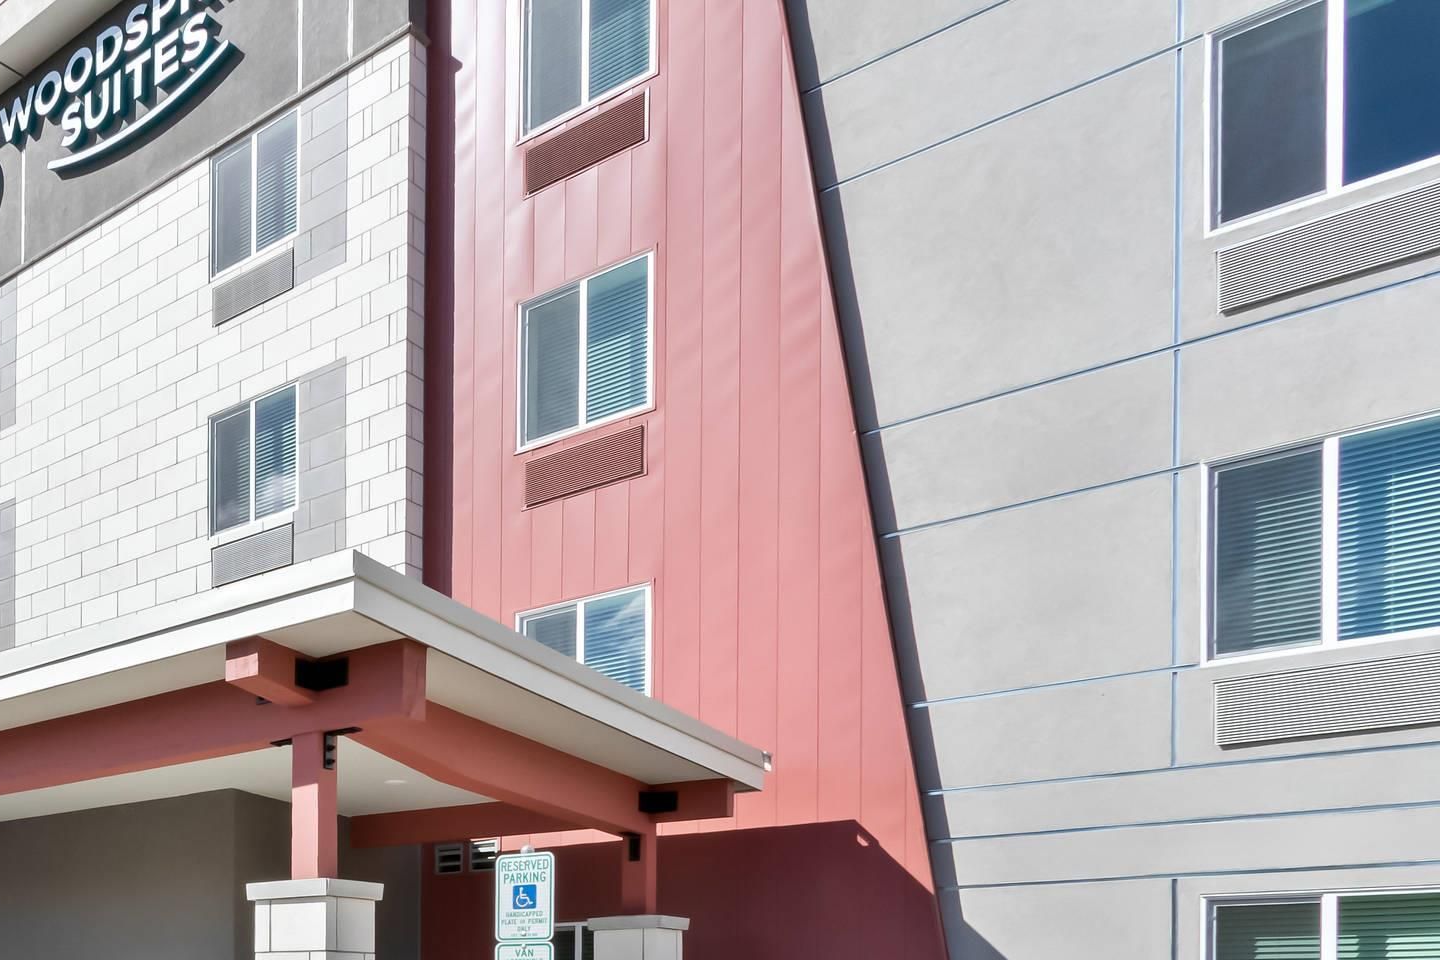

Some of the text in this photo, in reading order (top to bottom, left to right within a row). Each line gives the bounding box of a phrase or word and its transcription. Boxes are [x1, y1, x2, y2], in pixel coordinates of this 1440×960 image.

[61, 12, 208, 147] SUITES
[501, 859, 549, 872] RESERVED
[504, 872, 546, 884] PARKING
[515, 949, 534, 957] VAN
